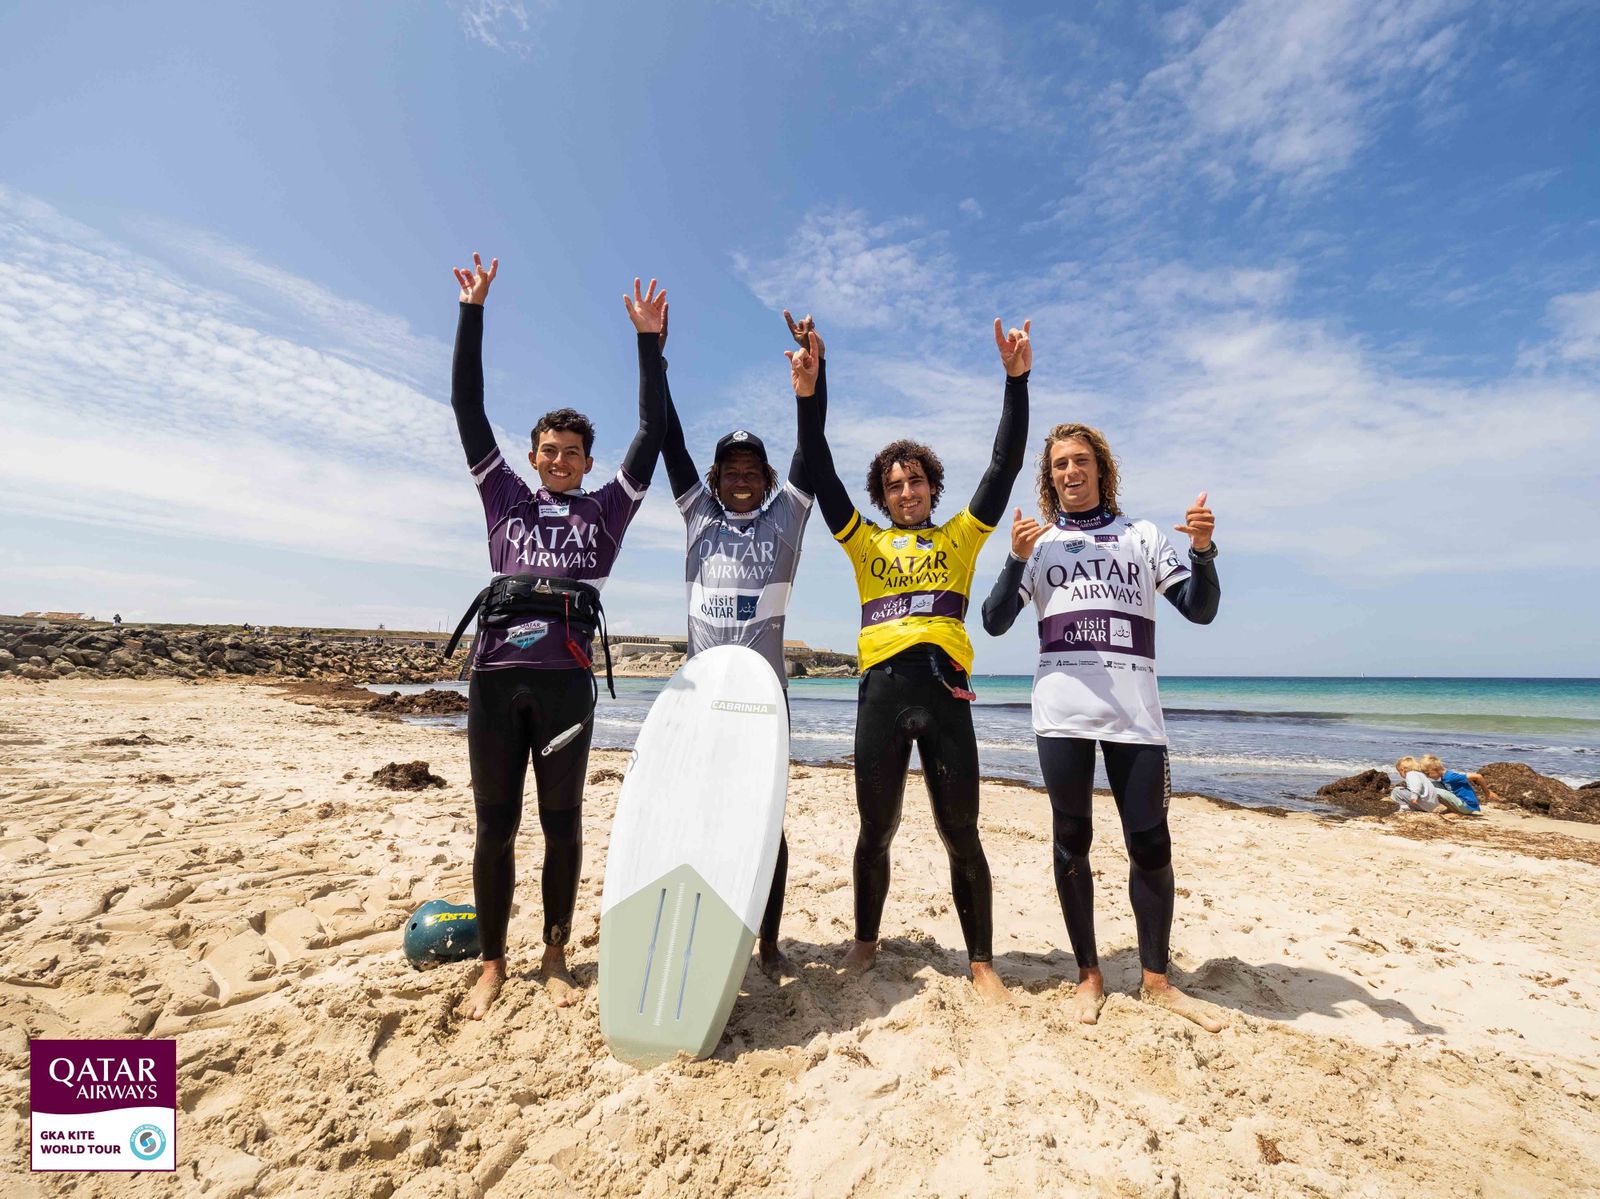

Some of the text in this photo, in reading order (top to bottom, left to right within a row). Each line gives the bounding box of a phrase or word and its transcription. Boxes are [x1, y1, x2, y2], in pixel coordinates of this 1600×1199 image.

[506, 517, 598, 549] QATAR
[516, 550, 598, 569] AIRWAYS
[700, 539, 775, 564] QATAR
[871, 551, 948, 580] QATAR
[884, 572, 948, 589] AIRWAYS
[1046, 559, 1140, 590] QATAR
[709, 595, 735, 606] visit
[1071, 584, 1143, 606] AIRWAYS
[701, 604, 734, 618] QATAR
[883, 598, 909, 609] visit
[871, 606, 910, 621] QATAR
[1076, 617, 1107, 630] visit
[1064, 629, 1107, 644] QATAR
[712, 700, 768, 713] CABRINHA
